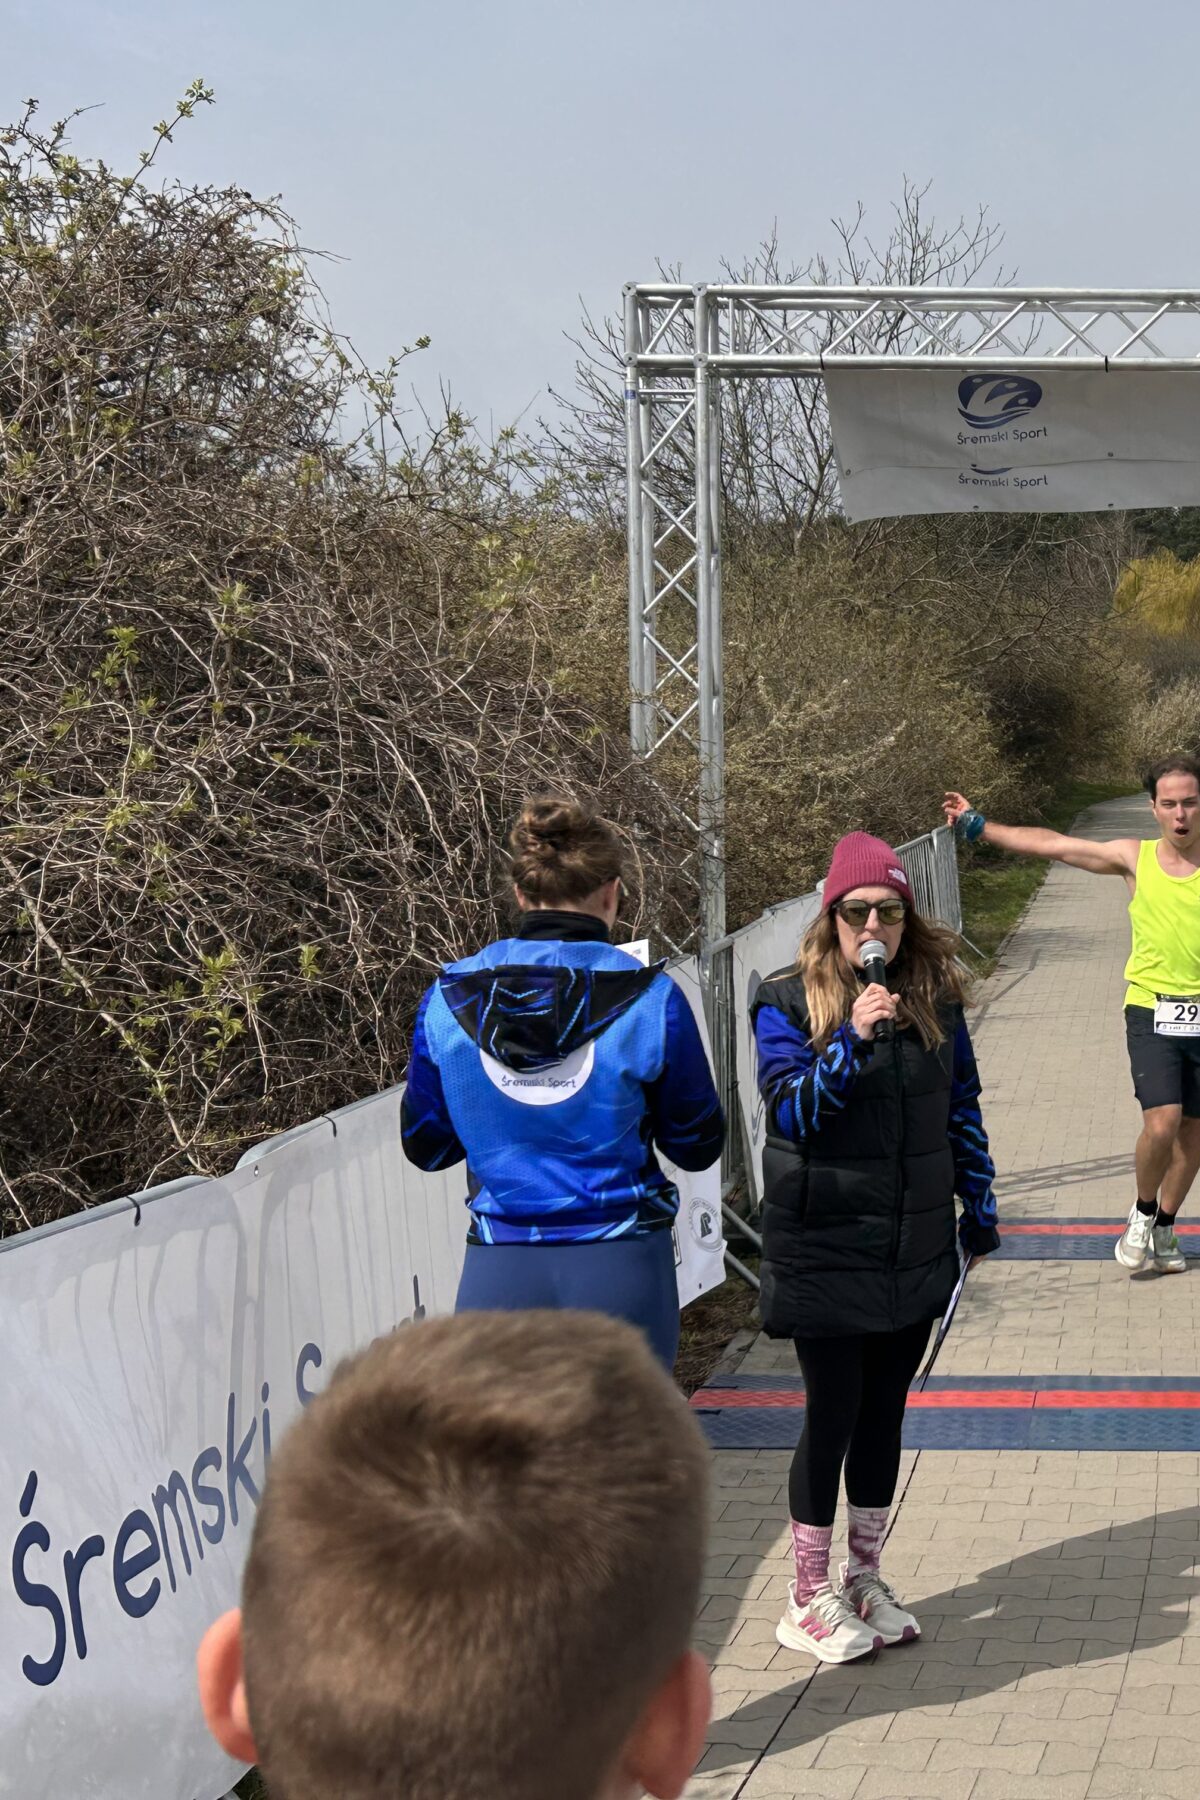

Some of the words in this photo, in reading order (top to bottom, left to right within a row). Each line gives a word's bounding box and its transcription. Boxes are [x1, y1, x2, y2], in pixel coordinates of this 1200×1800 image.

[957, 432, 1008, 446] Śremski
[1012, 427, 1048, 443] Sport
[1013, 474, 1049, 490] Sport
[1174, 1004, 1199, 1022] 29
[547, 1077, 577, 1089] Sport
[11, 1382, 273, 1687] Śremski
